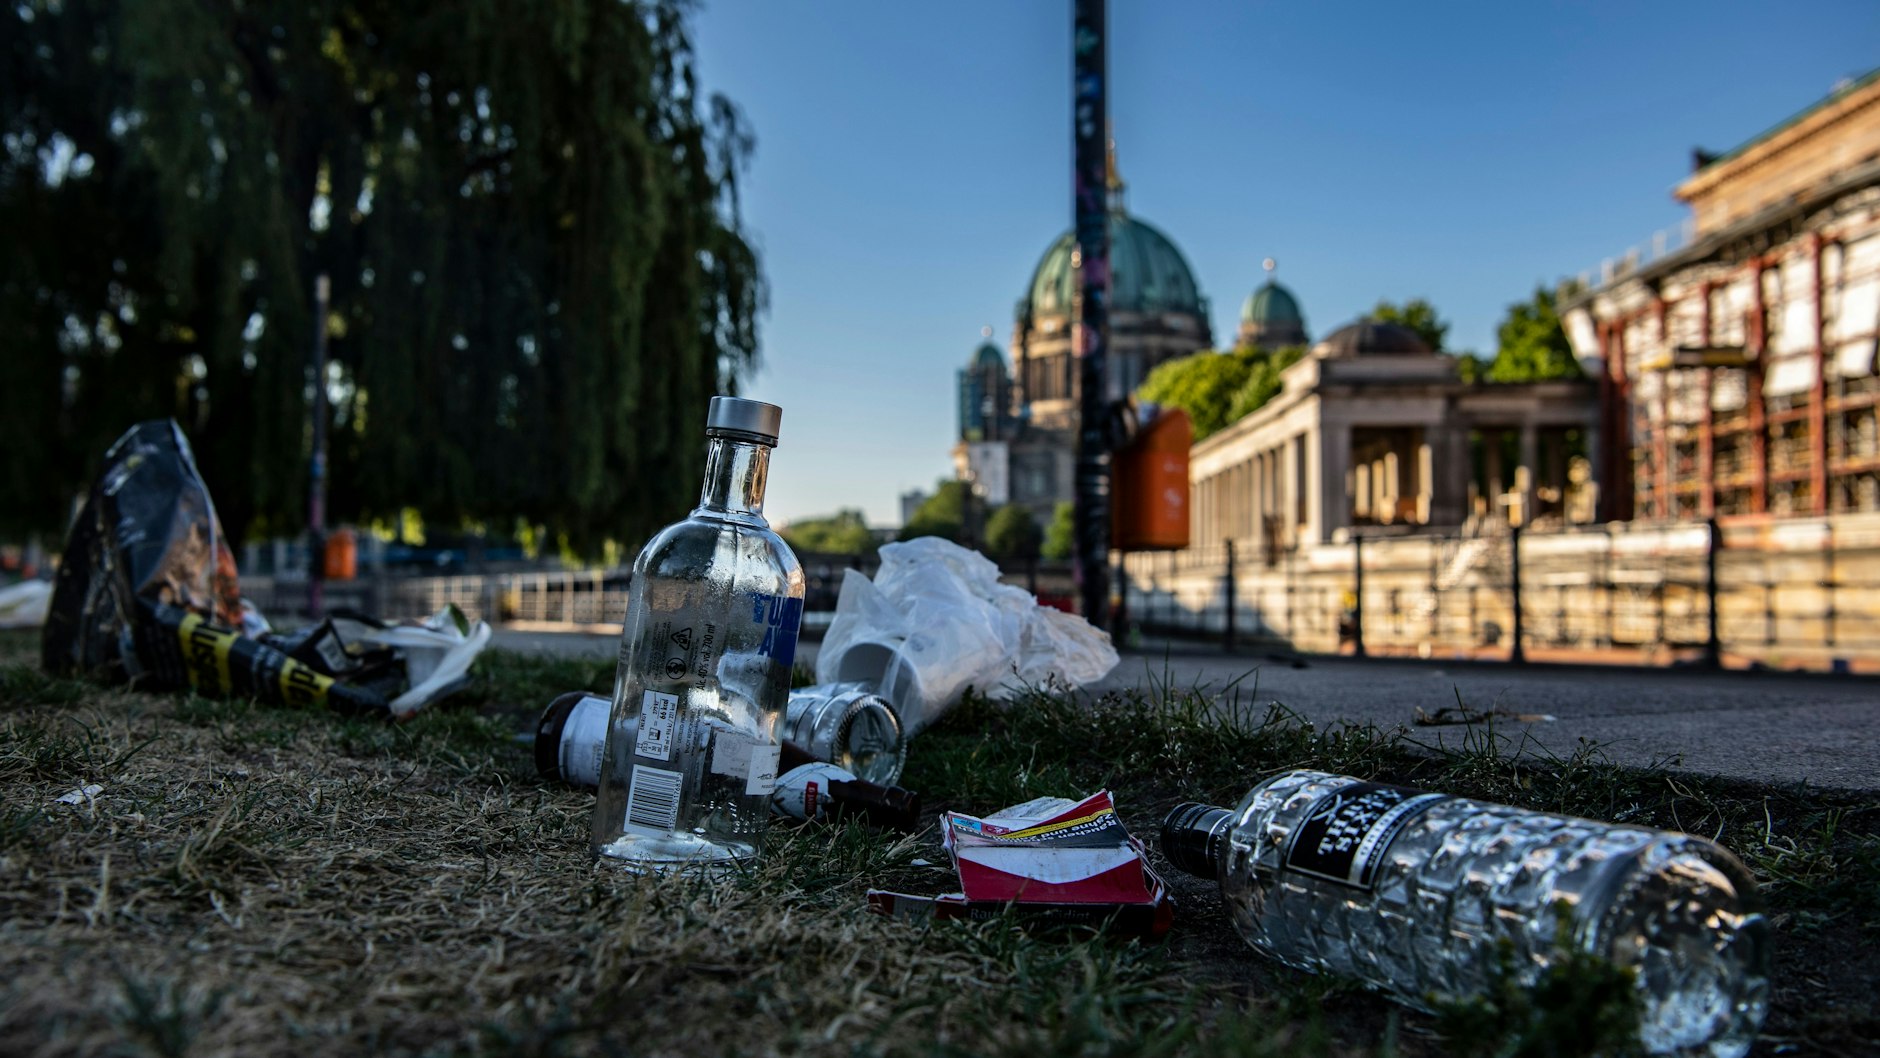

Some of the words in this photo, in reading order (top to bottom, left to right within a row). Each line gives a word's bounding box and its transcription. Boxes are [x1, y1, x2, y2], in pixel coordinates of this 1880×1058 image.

[702, 634, 713, 648] 700
[697, 662, 709, 679] 40%
[660, 712, 666, 720] 66
[1058, 819, 1117, 840] Rauchen
